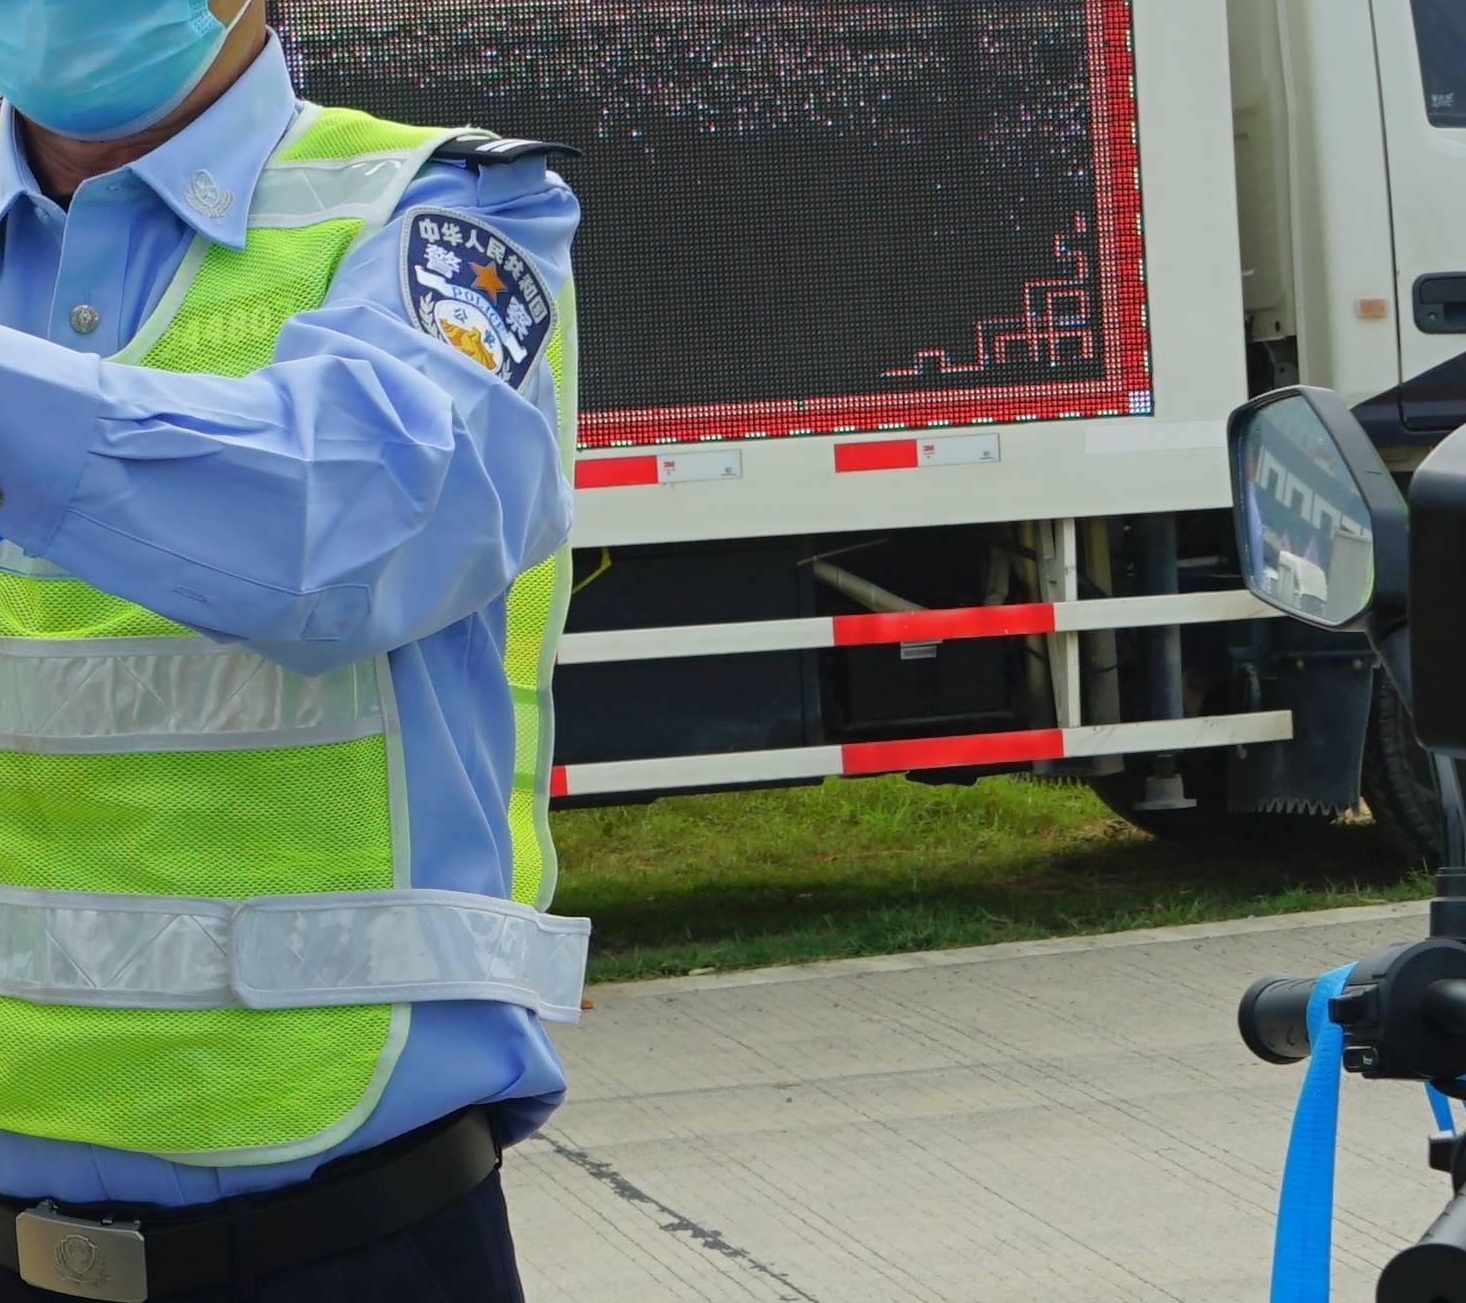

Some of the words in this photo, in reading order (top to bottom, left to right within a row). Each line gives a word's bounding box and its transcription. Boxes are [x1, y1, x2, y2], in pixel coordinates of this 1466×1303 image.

[418, 217, 548, 325] 中华人民共和国
[423, 243, 462, 279] 警
[505, 295, 533, 341] 察
[451, 285, 509, 335] POLICE
